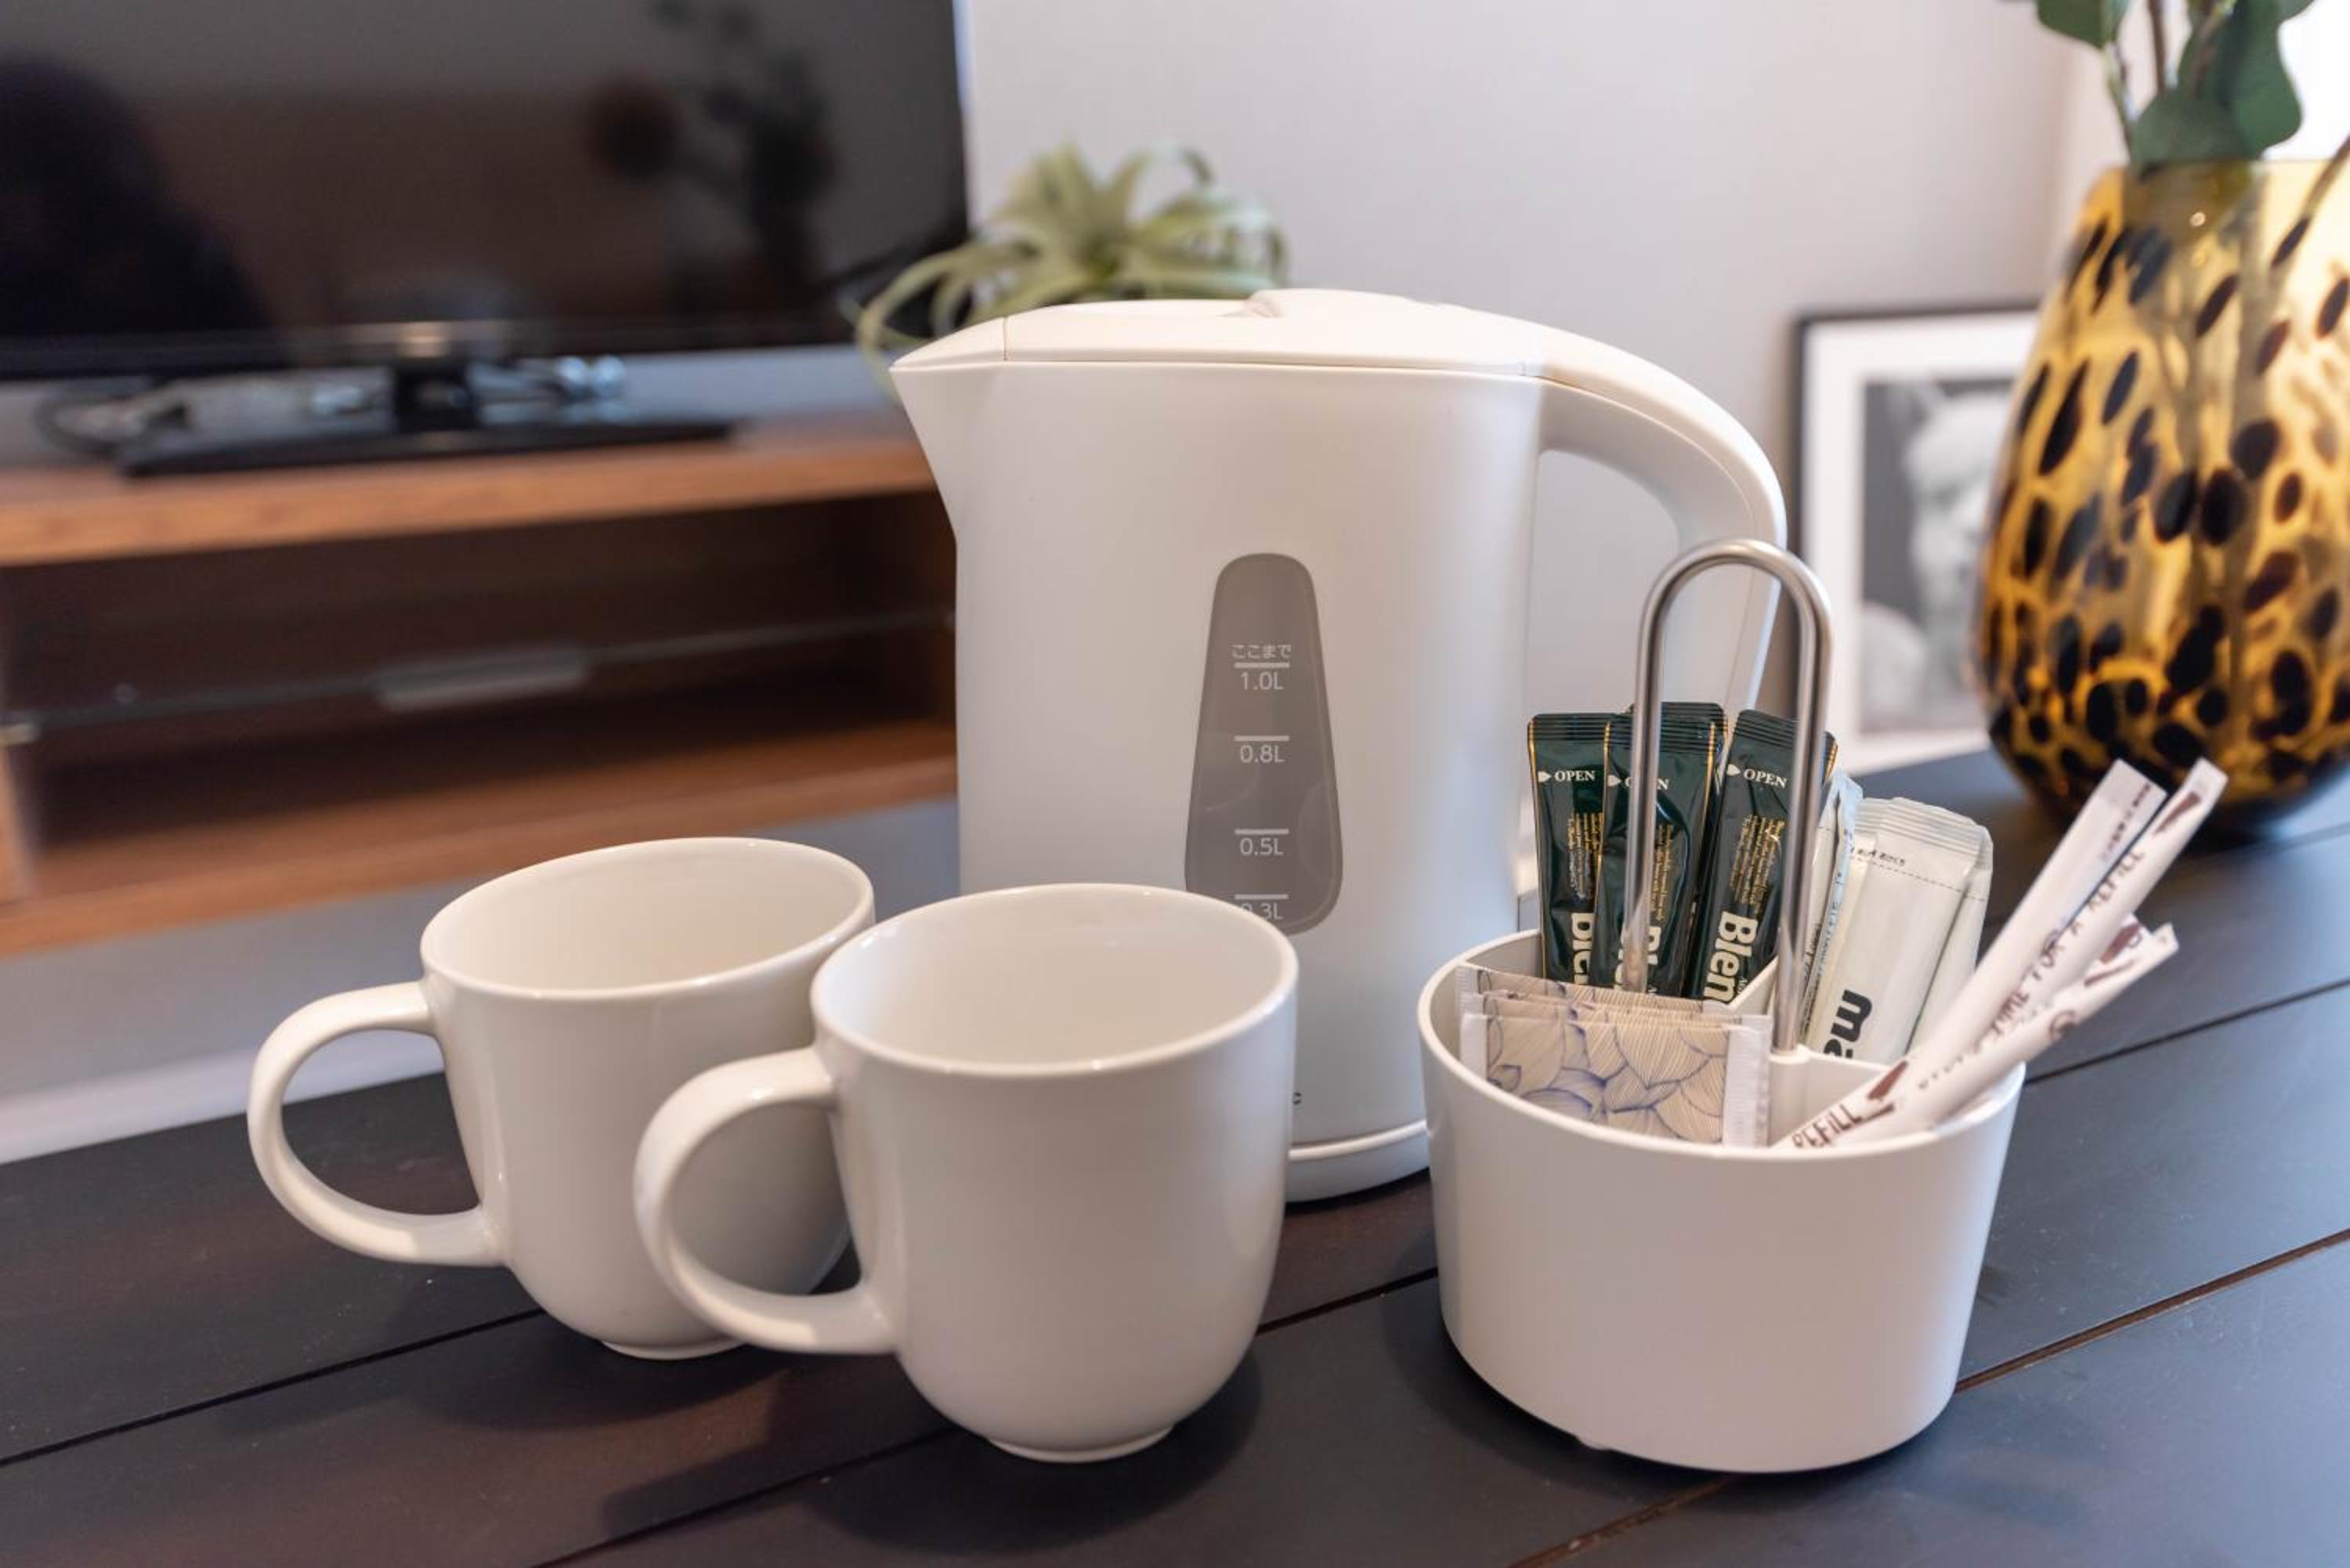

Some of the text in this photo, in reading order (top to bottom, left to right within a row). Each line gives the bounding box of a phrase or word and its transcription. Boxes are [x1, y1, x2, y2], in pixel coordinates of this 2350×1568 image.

[1232, 644, 1291, 659] ここまで
[1241, 671, 1284, 690] 1.0L
[1240, 745, 1285, 763] 0.8L
[1555, 770, 1596, 782] OPEN
[1743, 768, 1787, 788] OPEN
[1240, 838, 1284, 855] 0.5L
